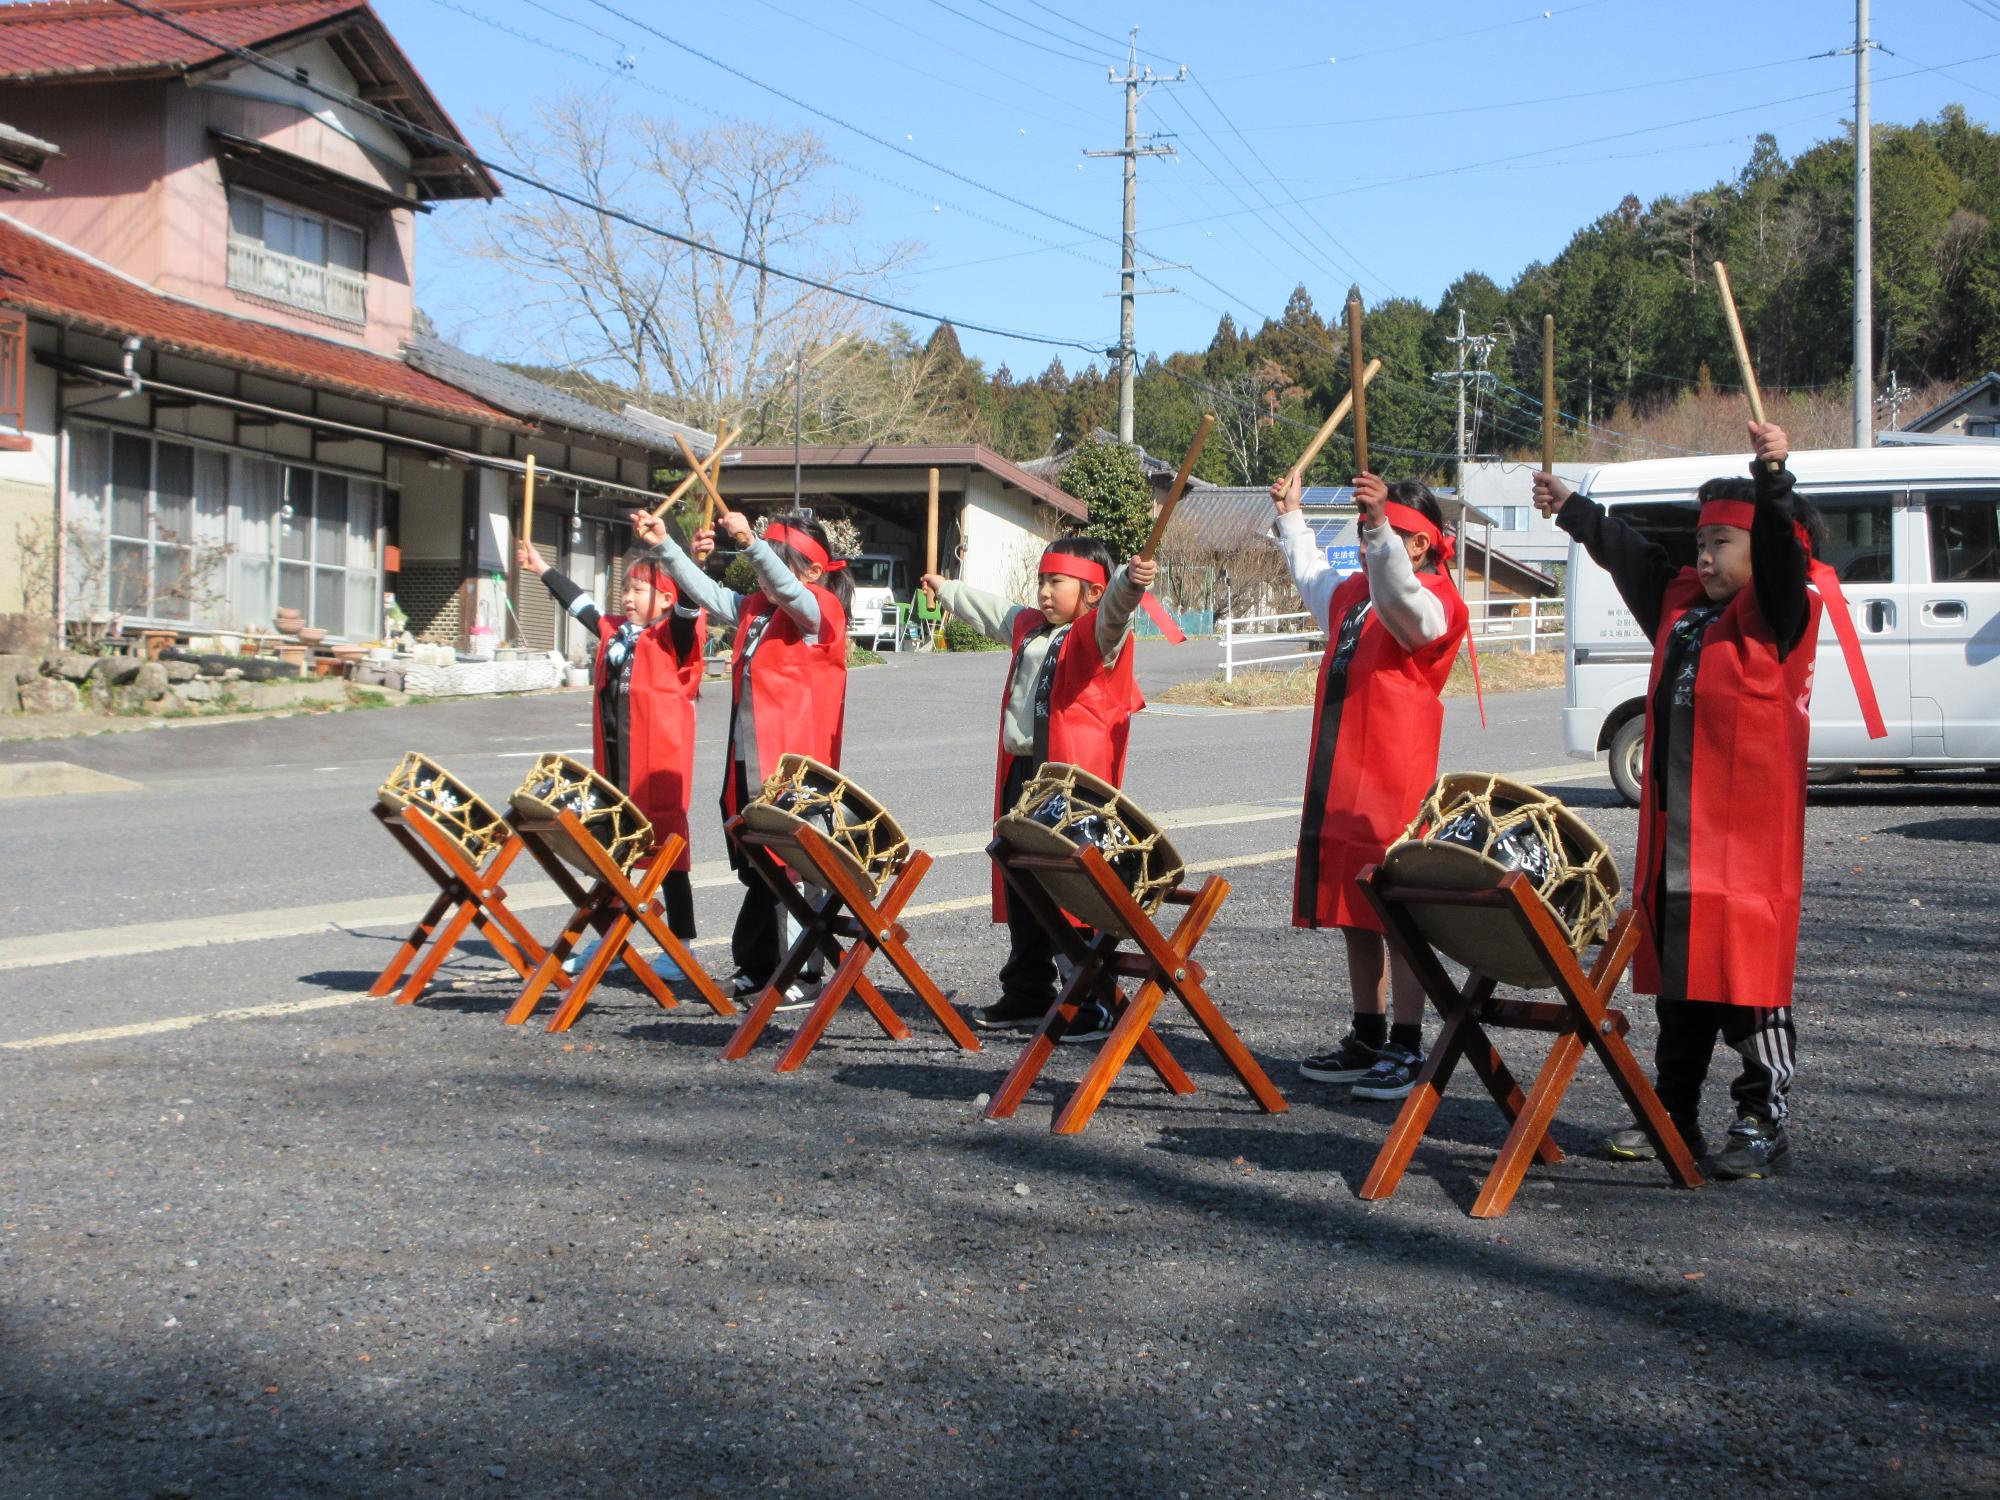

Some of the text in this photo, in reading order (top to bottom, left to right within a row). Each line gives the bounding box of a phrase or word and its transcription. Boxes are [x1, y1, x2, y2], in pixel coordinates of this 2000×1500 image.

[1332, 551, 1355, 559] 生活者
[1330, 559, 1358, 567] ファースト
